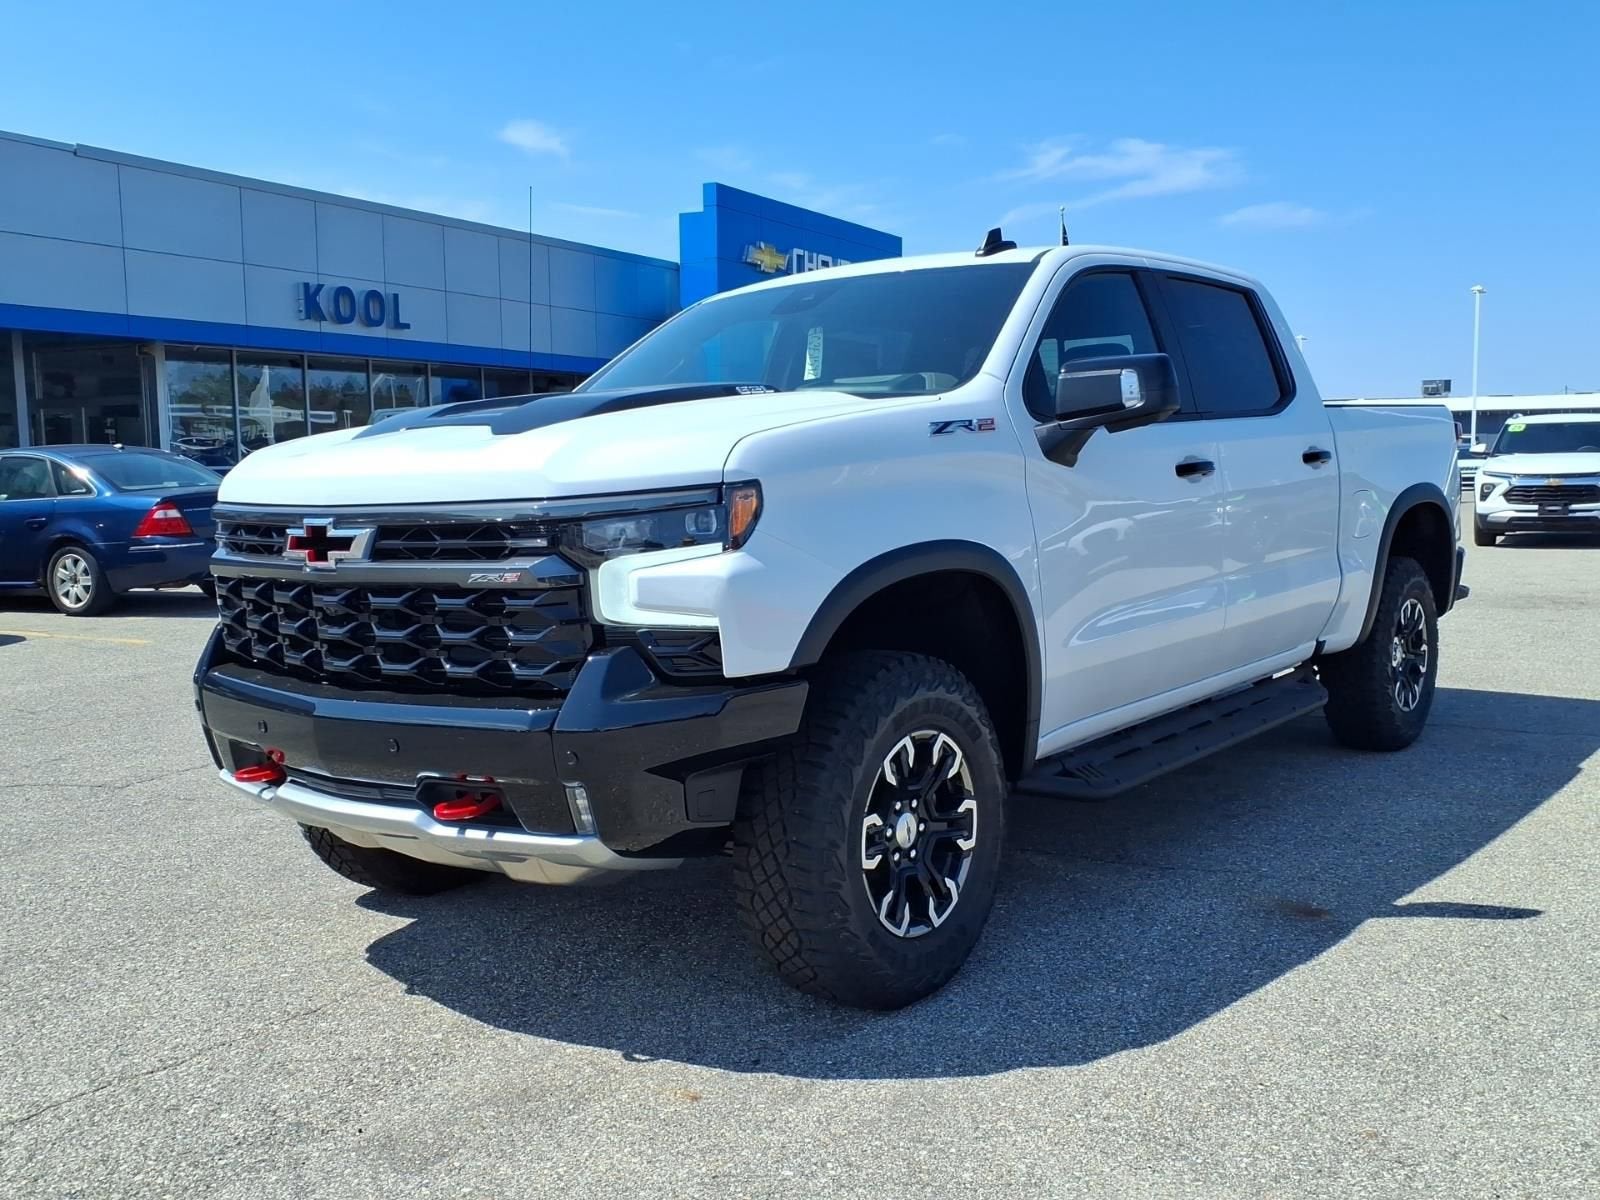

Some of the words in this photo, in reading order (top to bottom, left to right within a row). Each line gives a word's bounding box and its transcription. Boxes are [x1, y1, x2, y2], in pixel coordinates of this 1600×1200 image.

[300, 282, 411, 330] KOOL
[929, 418, 996, 435] ZR2
[467, 572, 521, 584] ZR2
